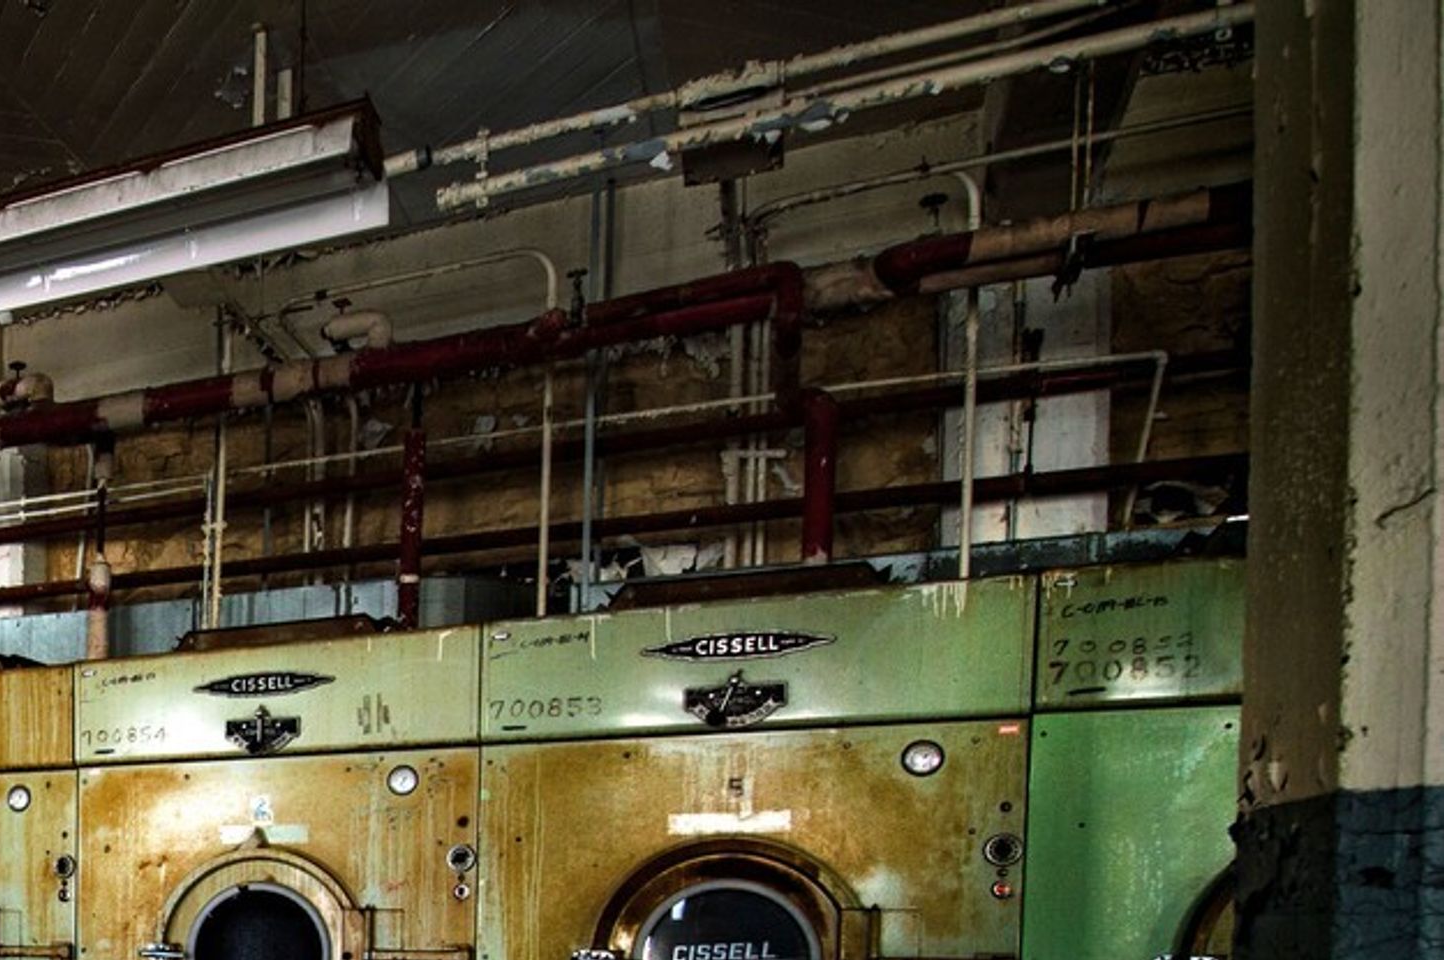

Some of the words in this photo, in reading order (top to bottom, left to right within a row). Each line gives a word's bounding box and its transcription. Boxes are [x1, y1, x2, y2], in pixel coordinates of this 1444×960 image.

[694, 634, 780, 657] CISSELL
[1048, 654, 1201, 685] 700852
[230, 676, 295, 692] CISSELL
[488, 695, 604, 721] 700853
